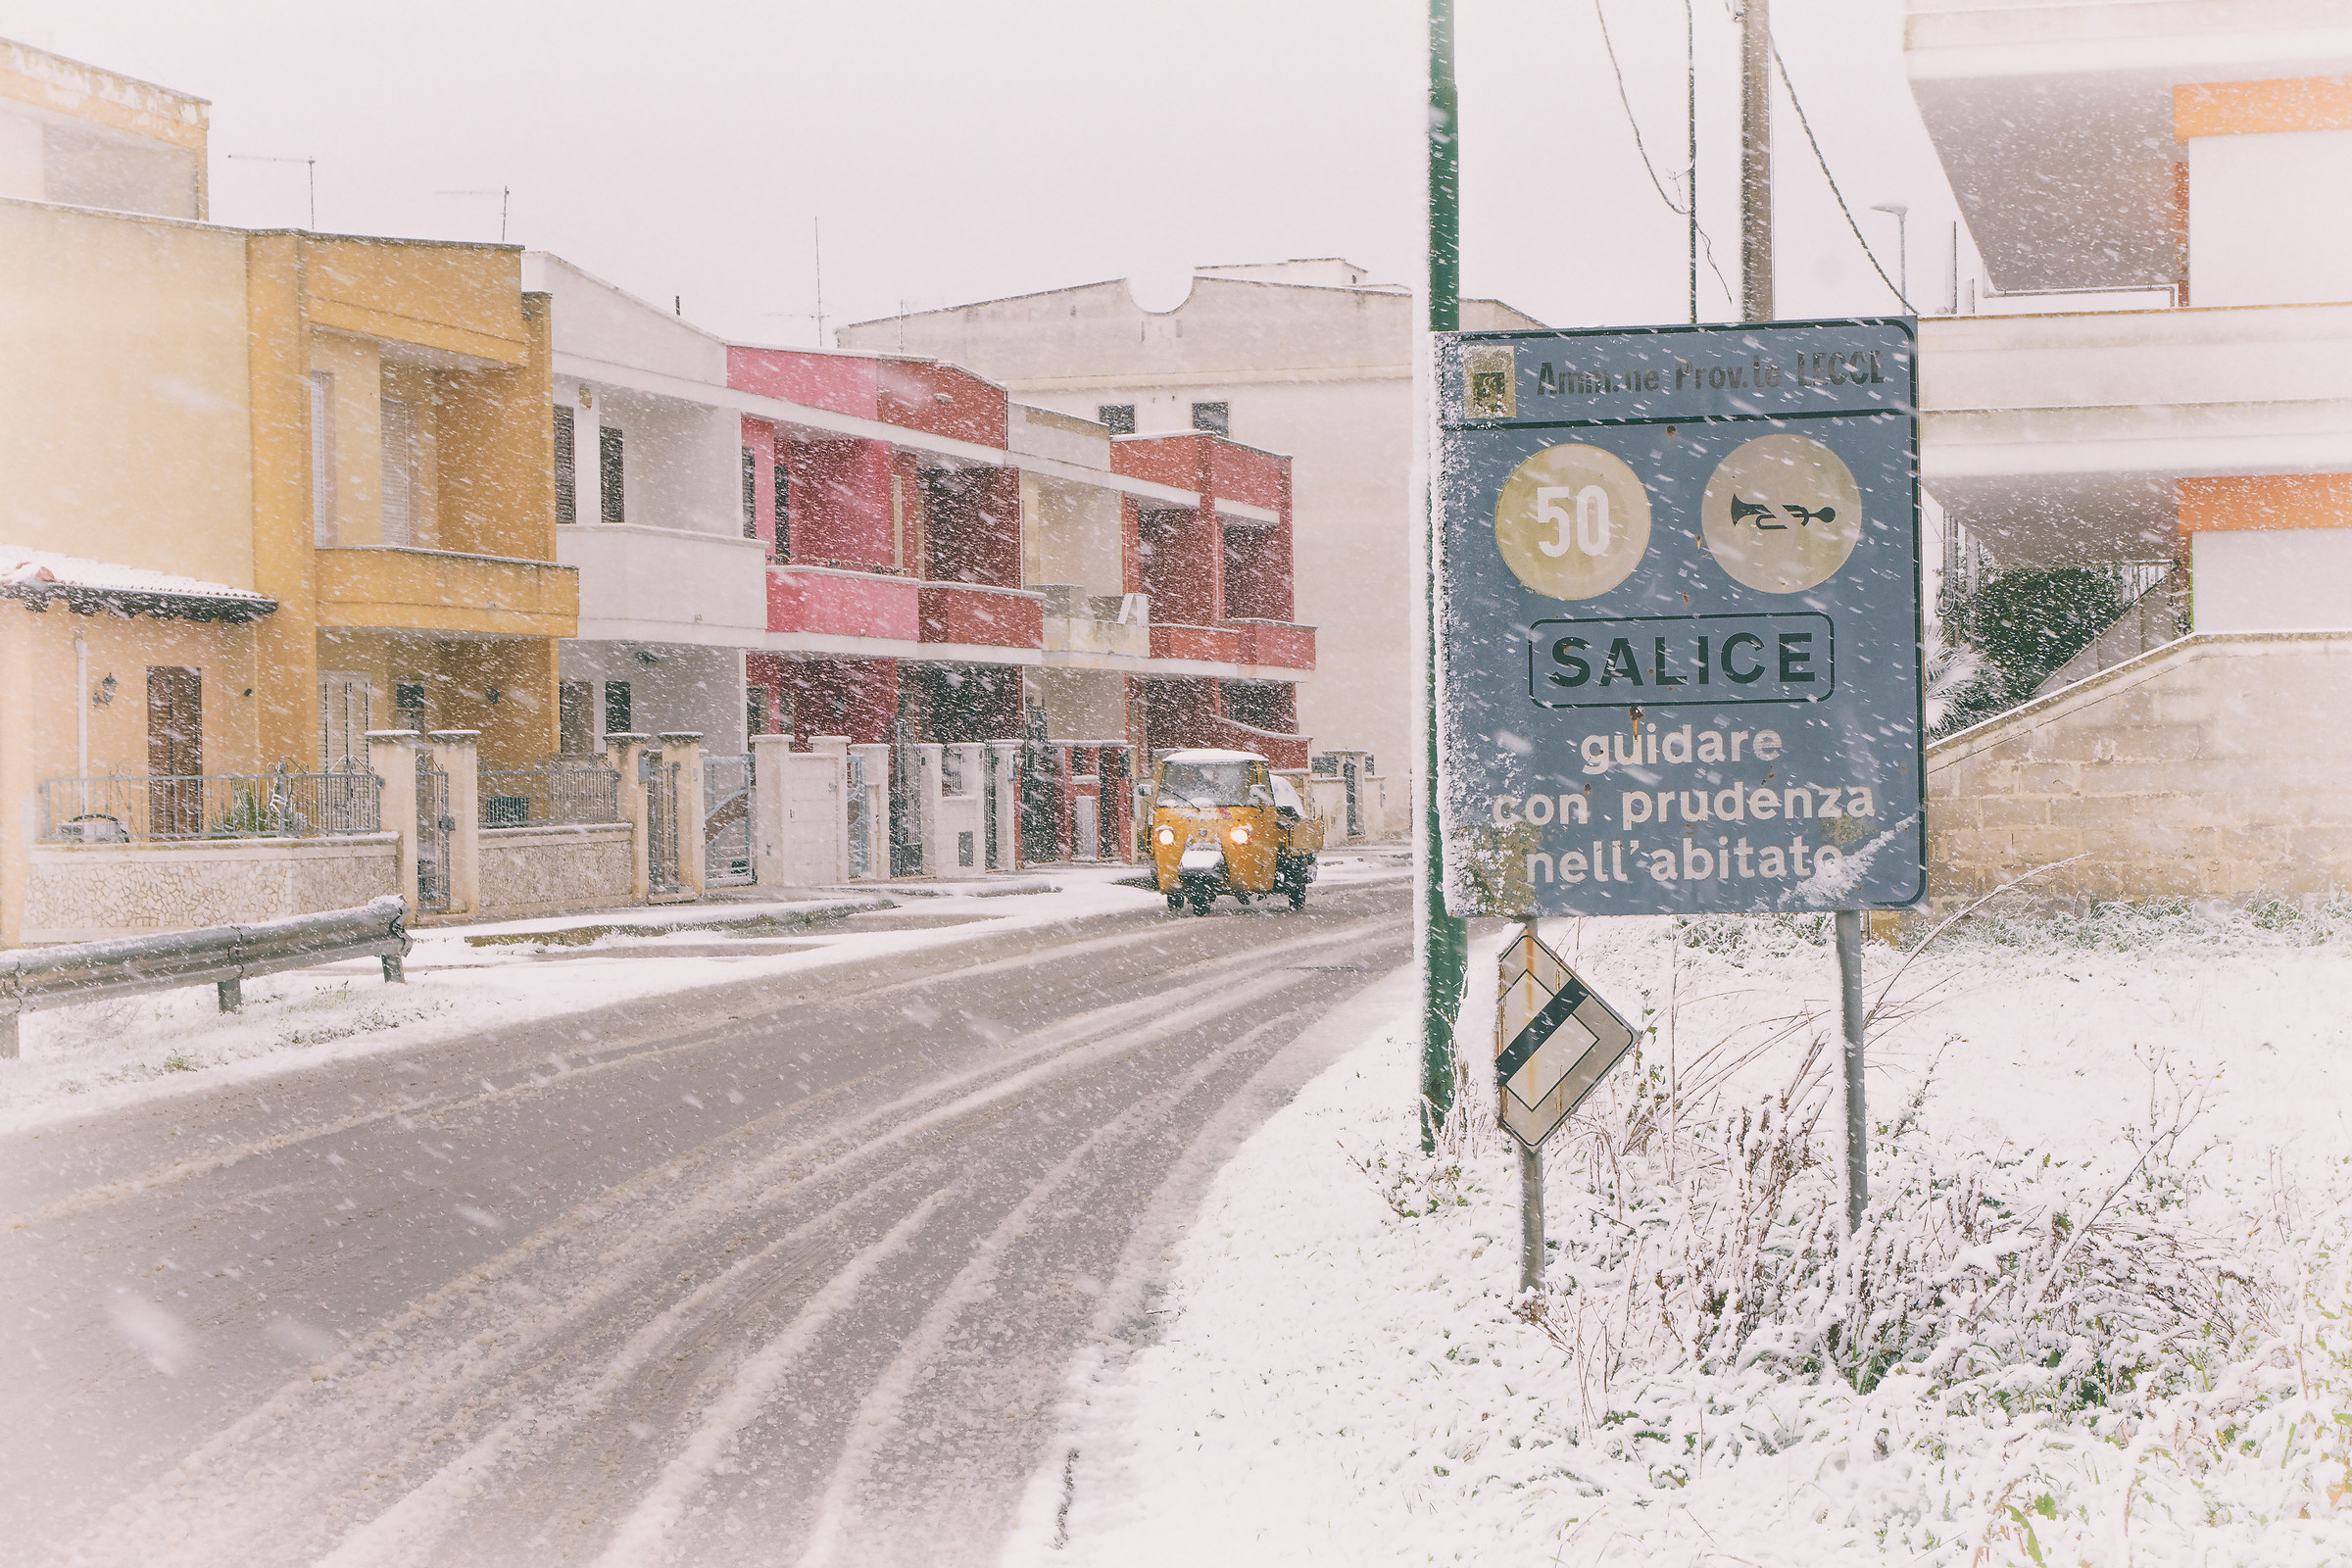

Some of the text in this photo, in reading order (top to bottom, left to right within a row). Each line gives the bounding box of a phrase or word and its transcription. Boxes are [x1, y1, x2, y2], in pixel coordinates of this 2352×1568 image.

[1797, 350, 1885, 386] LECCE
[1537, 485, 1610, 558] 50
[1549, 632, 1816, 687] SALICE
[1580, 724, 1783, 775] guidare
[1492, 782, 1875, 831] con prudenza
